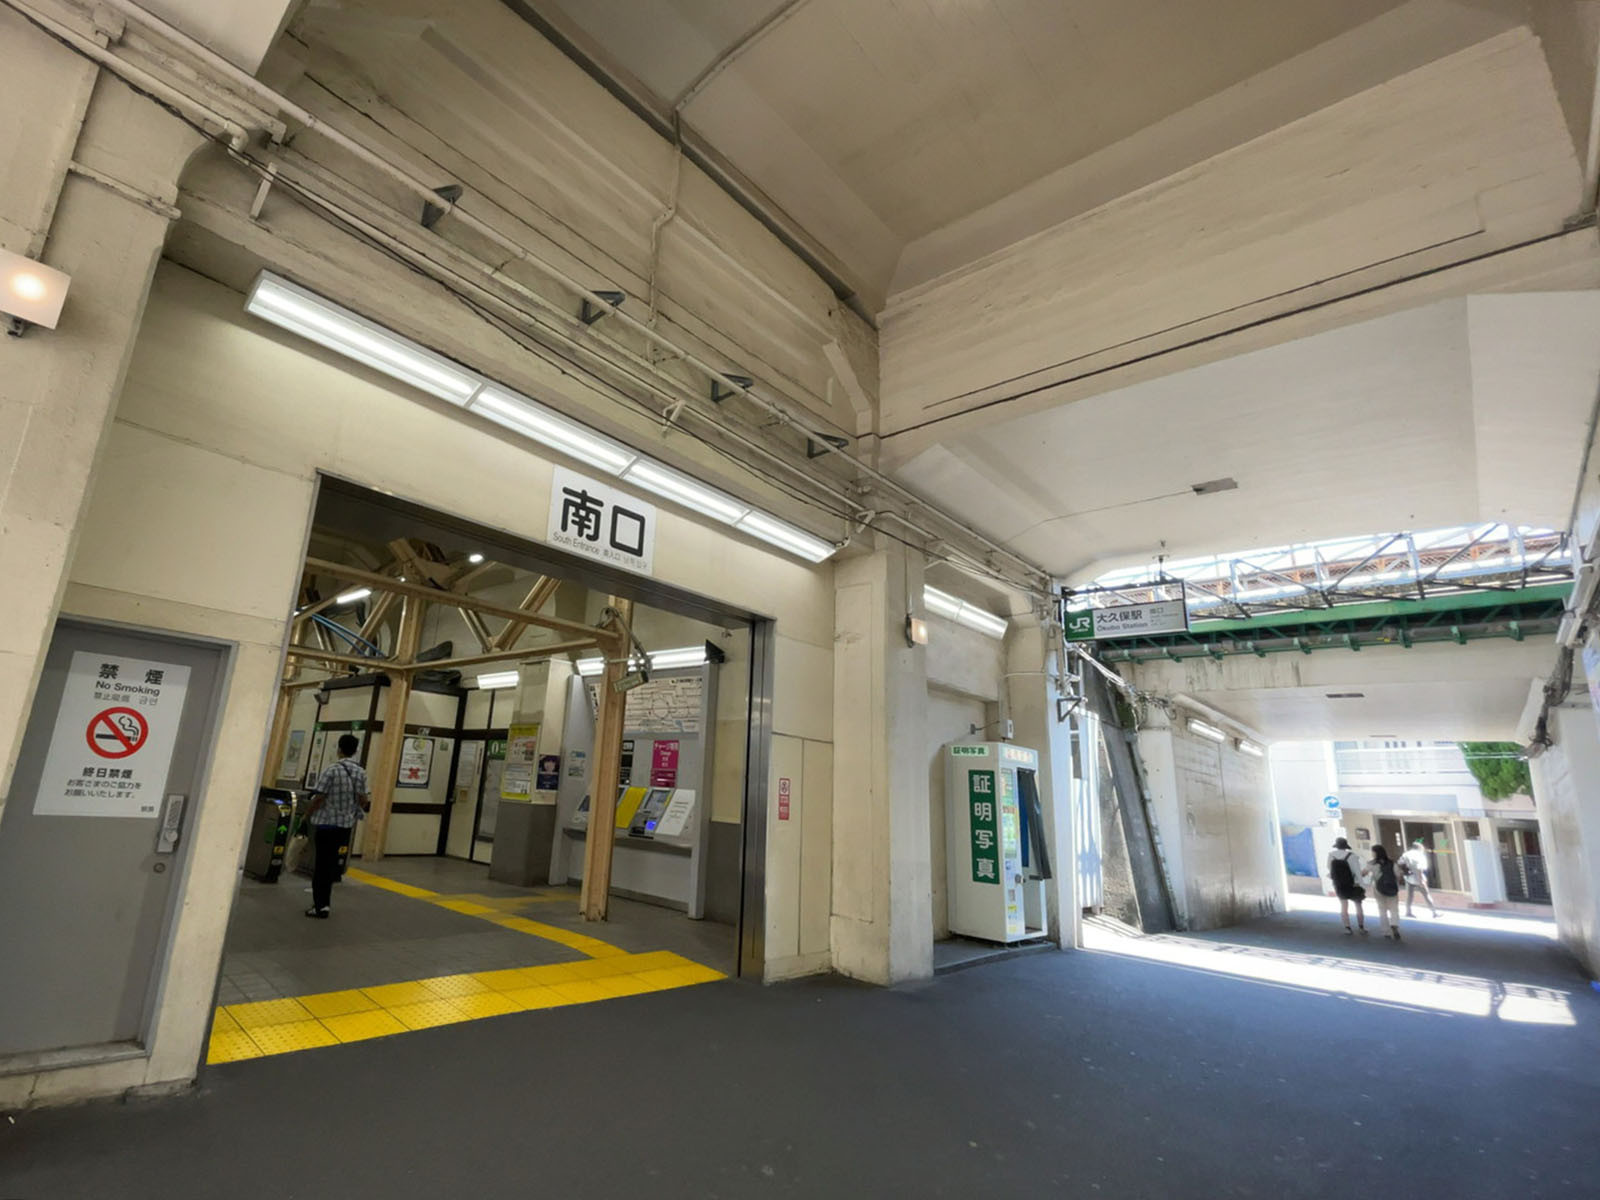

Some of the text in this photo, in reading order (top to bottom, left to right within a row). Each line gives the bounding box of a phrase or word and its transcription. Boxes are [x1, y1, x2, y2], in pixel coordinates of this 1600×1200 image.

[561, 486, 645, 557] 南口
[553, 531, 600, 554] South Entrance
[1068, 616, 1091, 630] JR
[1096, 609, 1143, 624] 大久保駅
[1096, 624, 1120, 633] Okubo
[1122, 621, 1148, 630] Station
[96, 680, 160, 697] No Smoking
[82, 766, 133, 779] 終日禁煙
[973, 774, 996, 879] 証明写真
